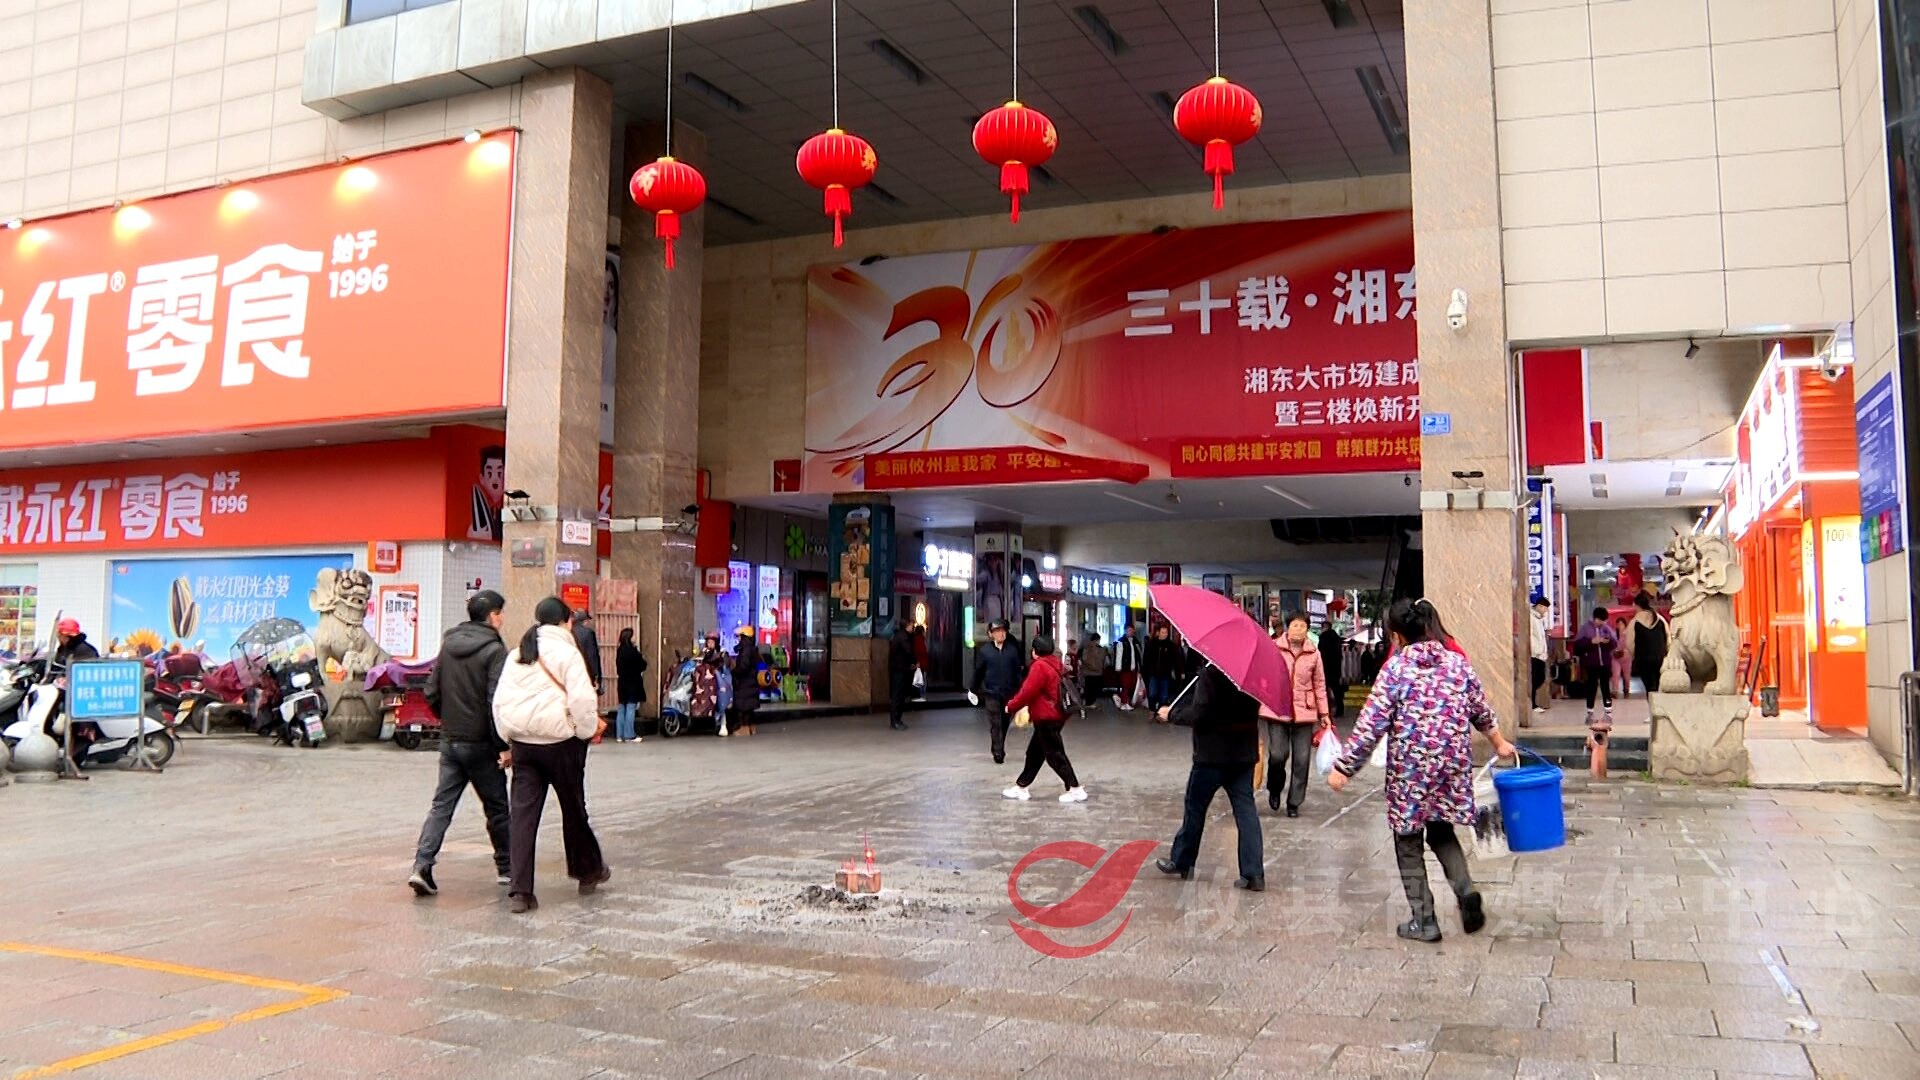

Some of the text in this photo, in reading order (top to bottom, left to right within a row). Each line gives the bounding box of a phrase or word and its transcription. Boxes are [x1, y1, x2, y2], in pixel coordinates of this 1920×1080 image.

[331, 230, 377, 266] 始于
[328, 263, 389, 299] 1996
[1244, 359, 1420, 394] 湘东大市场建成
[874, 454, 997, 477] 美丽攸州是我家
[1182, 439, 1322, 464] 同心同德共建平安家园
[210, 494, 249, 515] 1996
